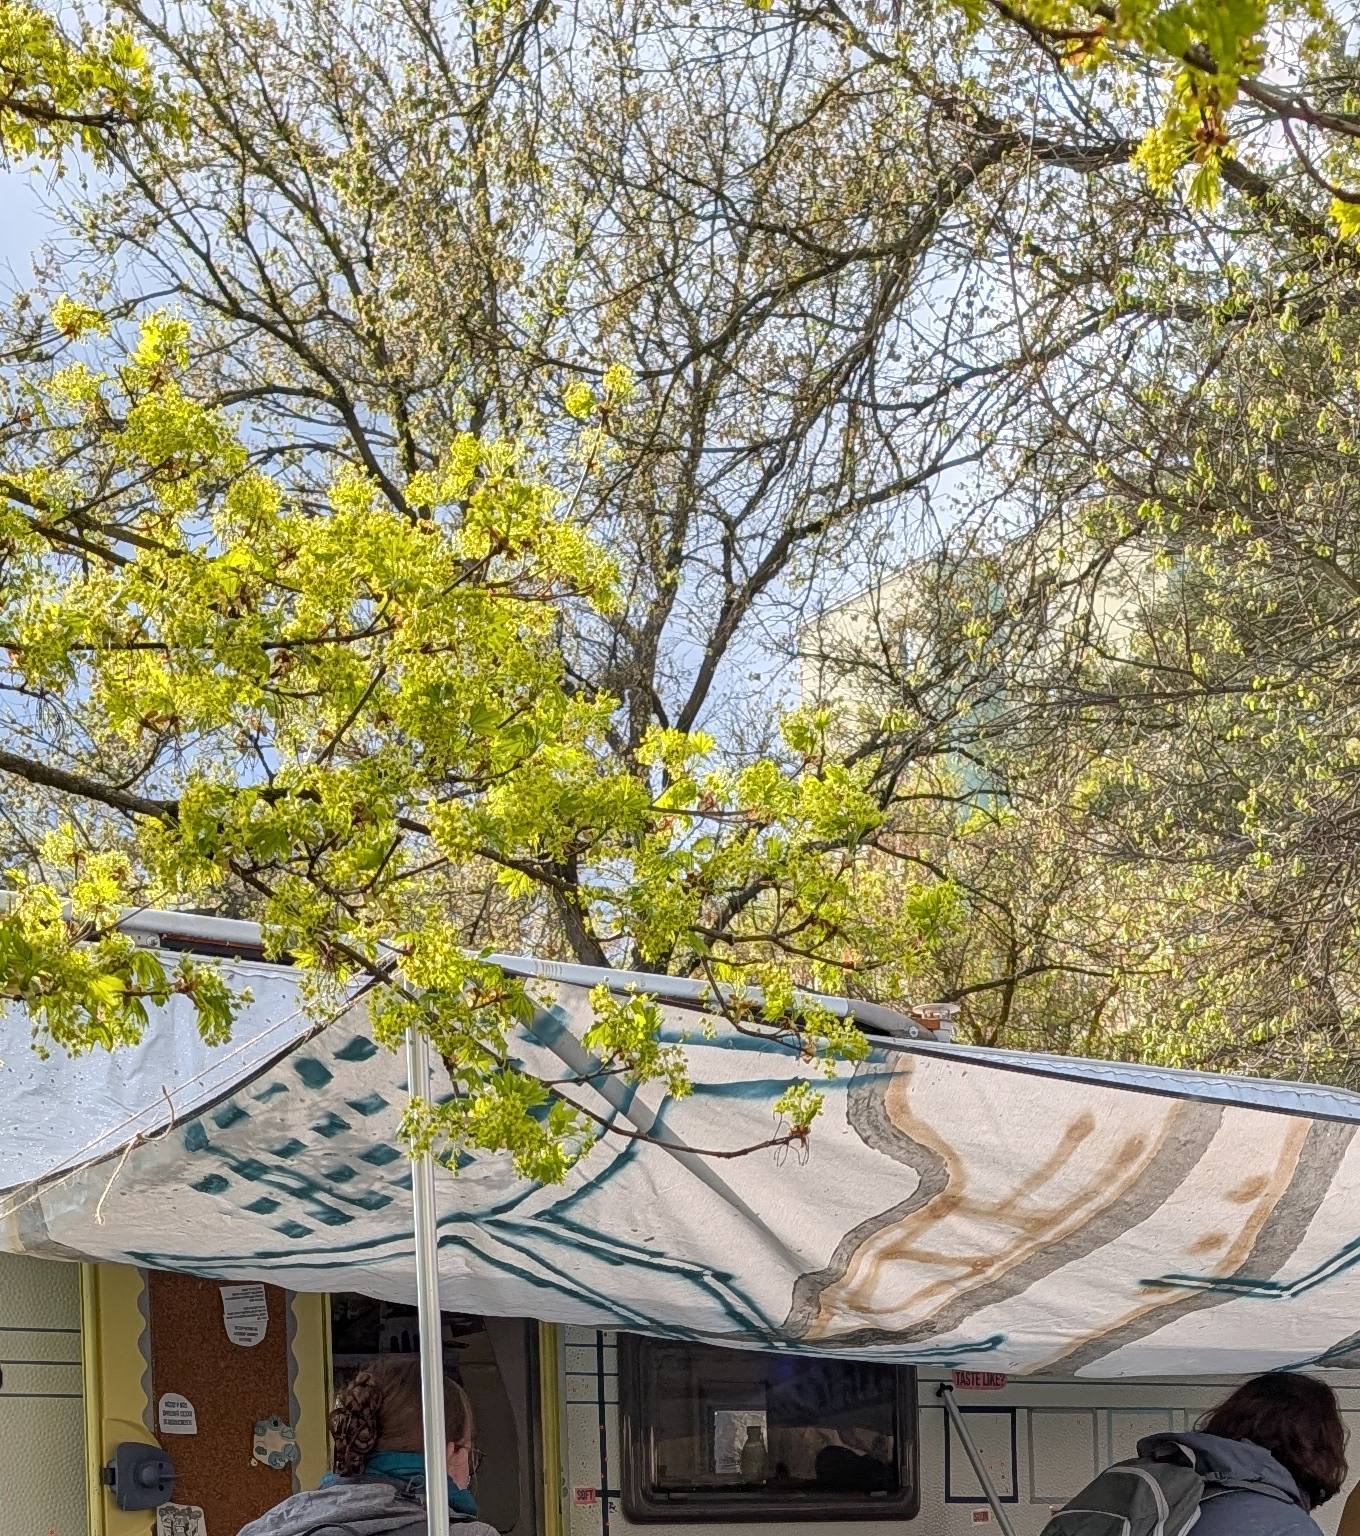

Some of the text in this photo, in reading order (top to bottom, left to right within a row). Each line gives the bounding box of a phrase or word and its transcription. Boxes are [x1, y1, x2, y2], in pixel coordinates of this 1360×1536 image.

[955, 1371, 1006, 1387] TASTE LIKE?
[576, 1489, 594, 1501] SOFT
